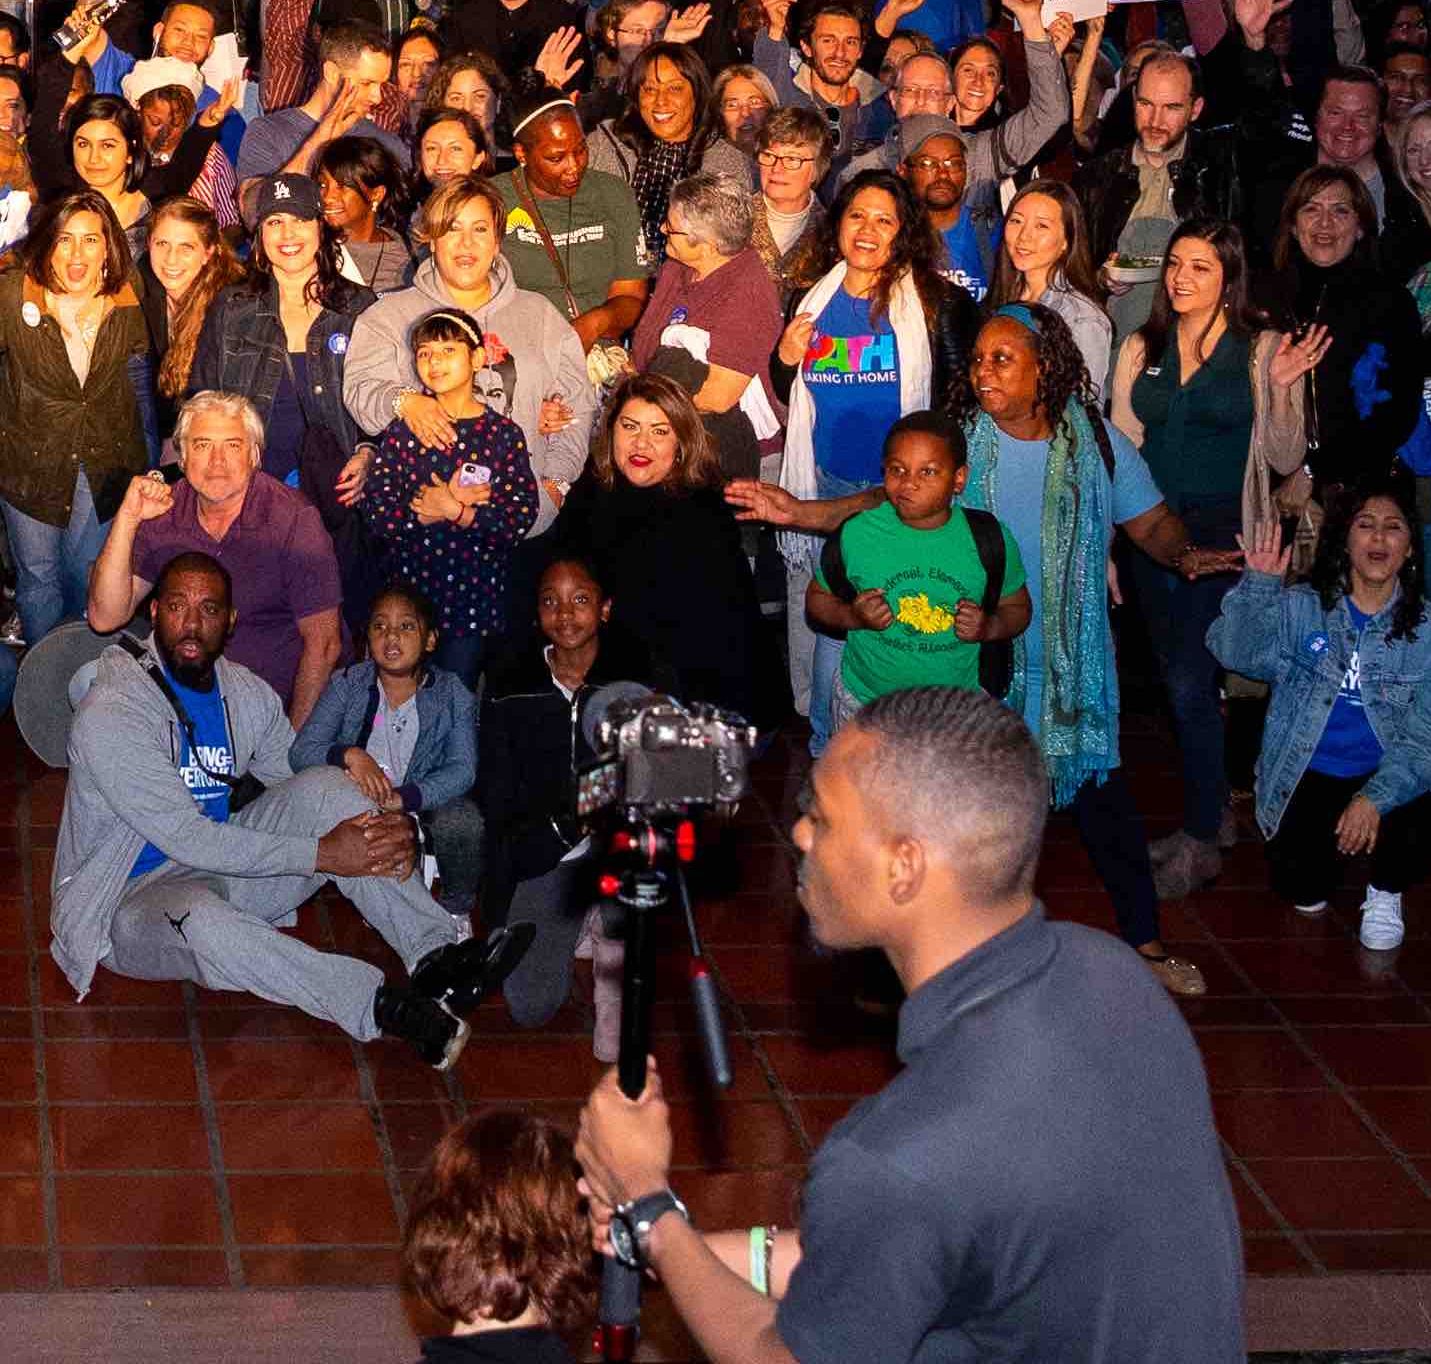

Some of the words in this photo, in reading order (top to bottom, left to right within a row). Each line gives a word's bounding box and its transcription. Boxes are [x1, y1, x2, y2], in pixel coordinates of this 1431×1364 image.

[802, 334, 896, 372] PATH
[844, 372, 855, 384] IT
[858, 371, 896, 383] HOME
